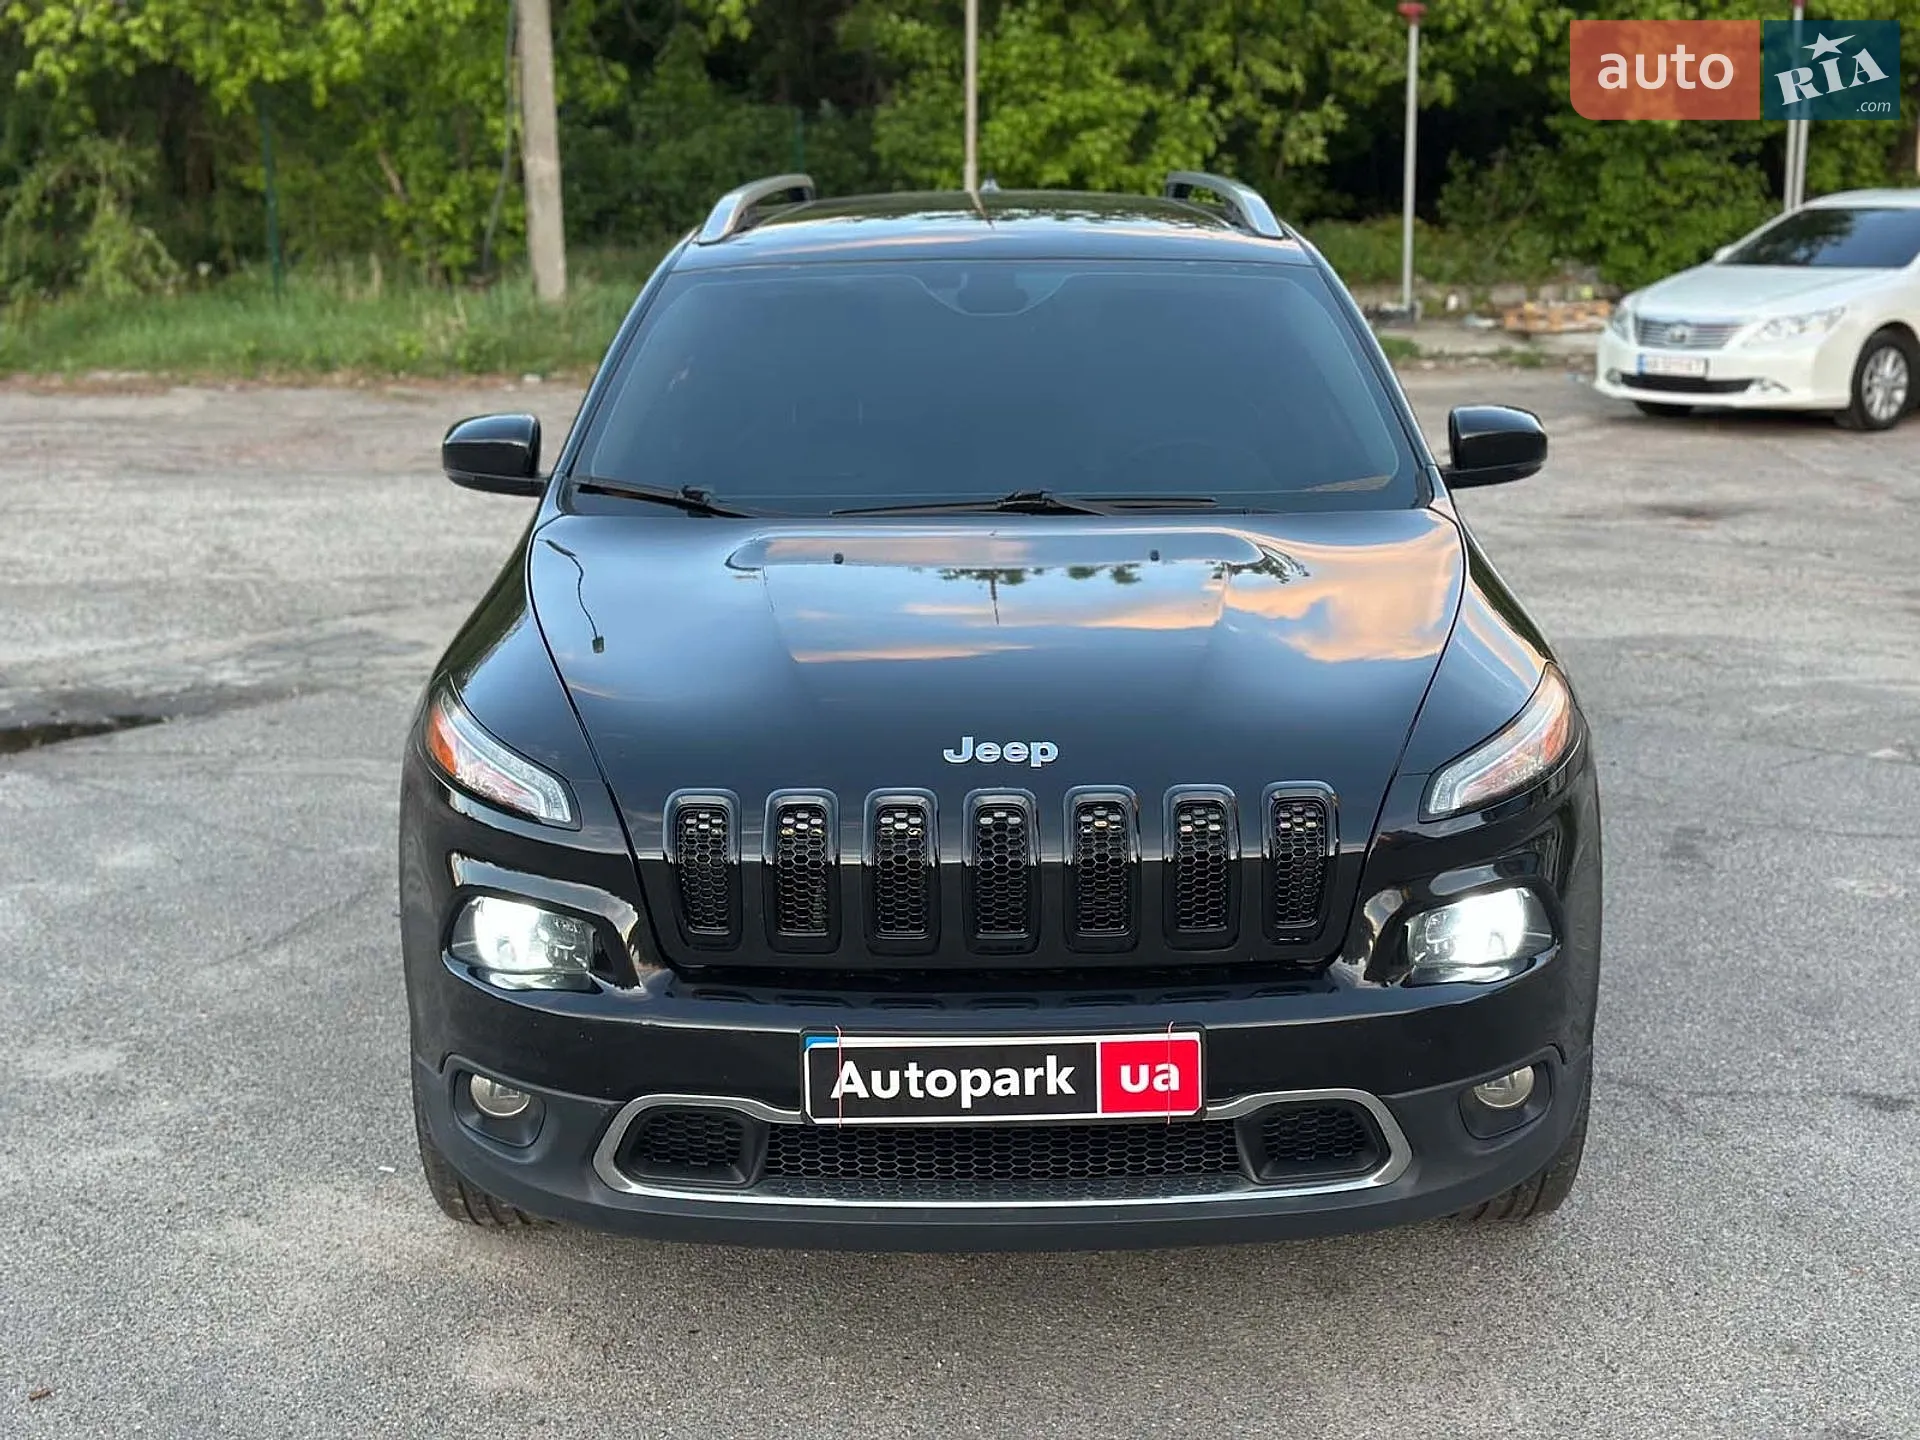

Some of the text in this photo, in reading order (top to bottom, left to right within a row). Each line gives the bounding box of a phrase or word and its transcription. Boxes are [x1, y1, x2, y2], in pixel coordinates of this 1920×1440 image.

[943, 736, 1059, 768] Jeep
[830, 1054, 1180, 1109] Autopark ua
